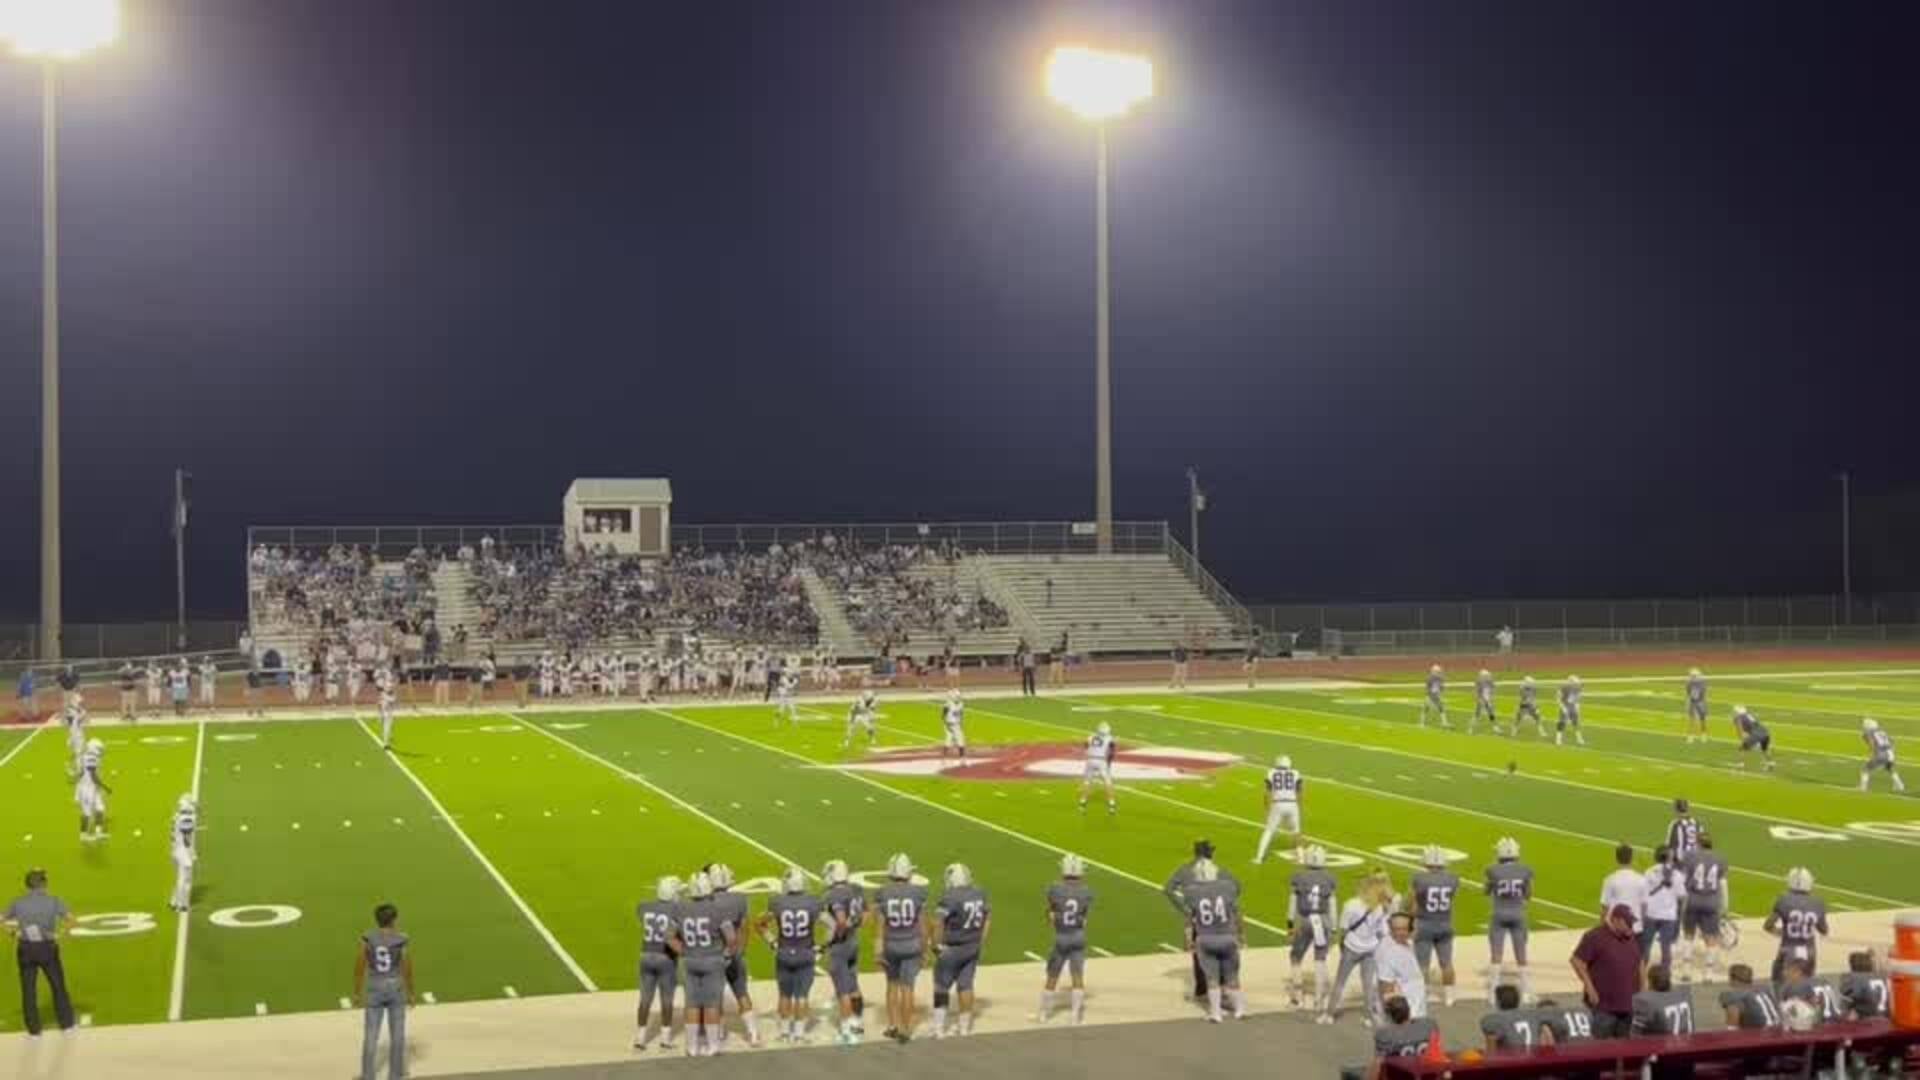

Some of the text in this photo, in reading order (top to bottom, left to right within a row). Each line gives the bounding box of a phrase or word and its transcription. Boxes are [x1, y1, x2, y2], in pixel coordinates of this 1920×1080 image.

[1272, 772, 1294, 791] 88
[1694, 863, 1718, 890] 44
[886, 899, 915, 928] 50
[1062, 899, 1079, 926] 2
[1199, 895, 1229, 926] 64
[1425, 886, 1451, 913] 55
[643, 912, 669, 943] 53
[780, 909, 810, 938] 62
[963, 900, 985, 930] 75
[682, 917, 712, 948] 65
